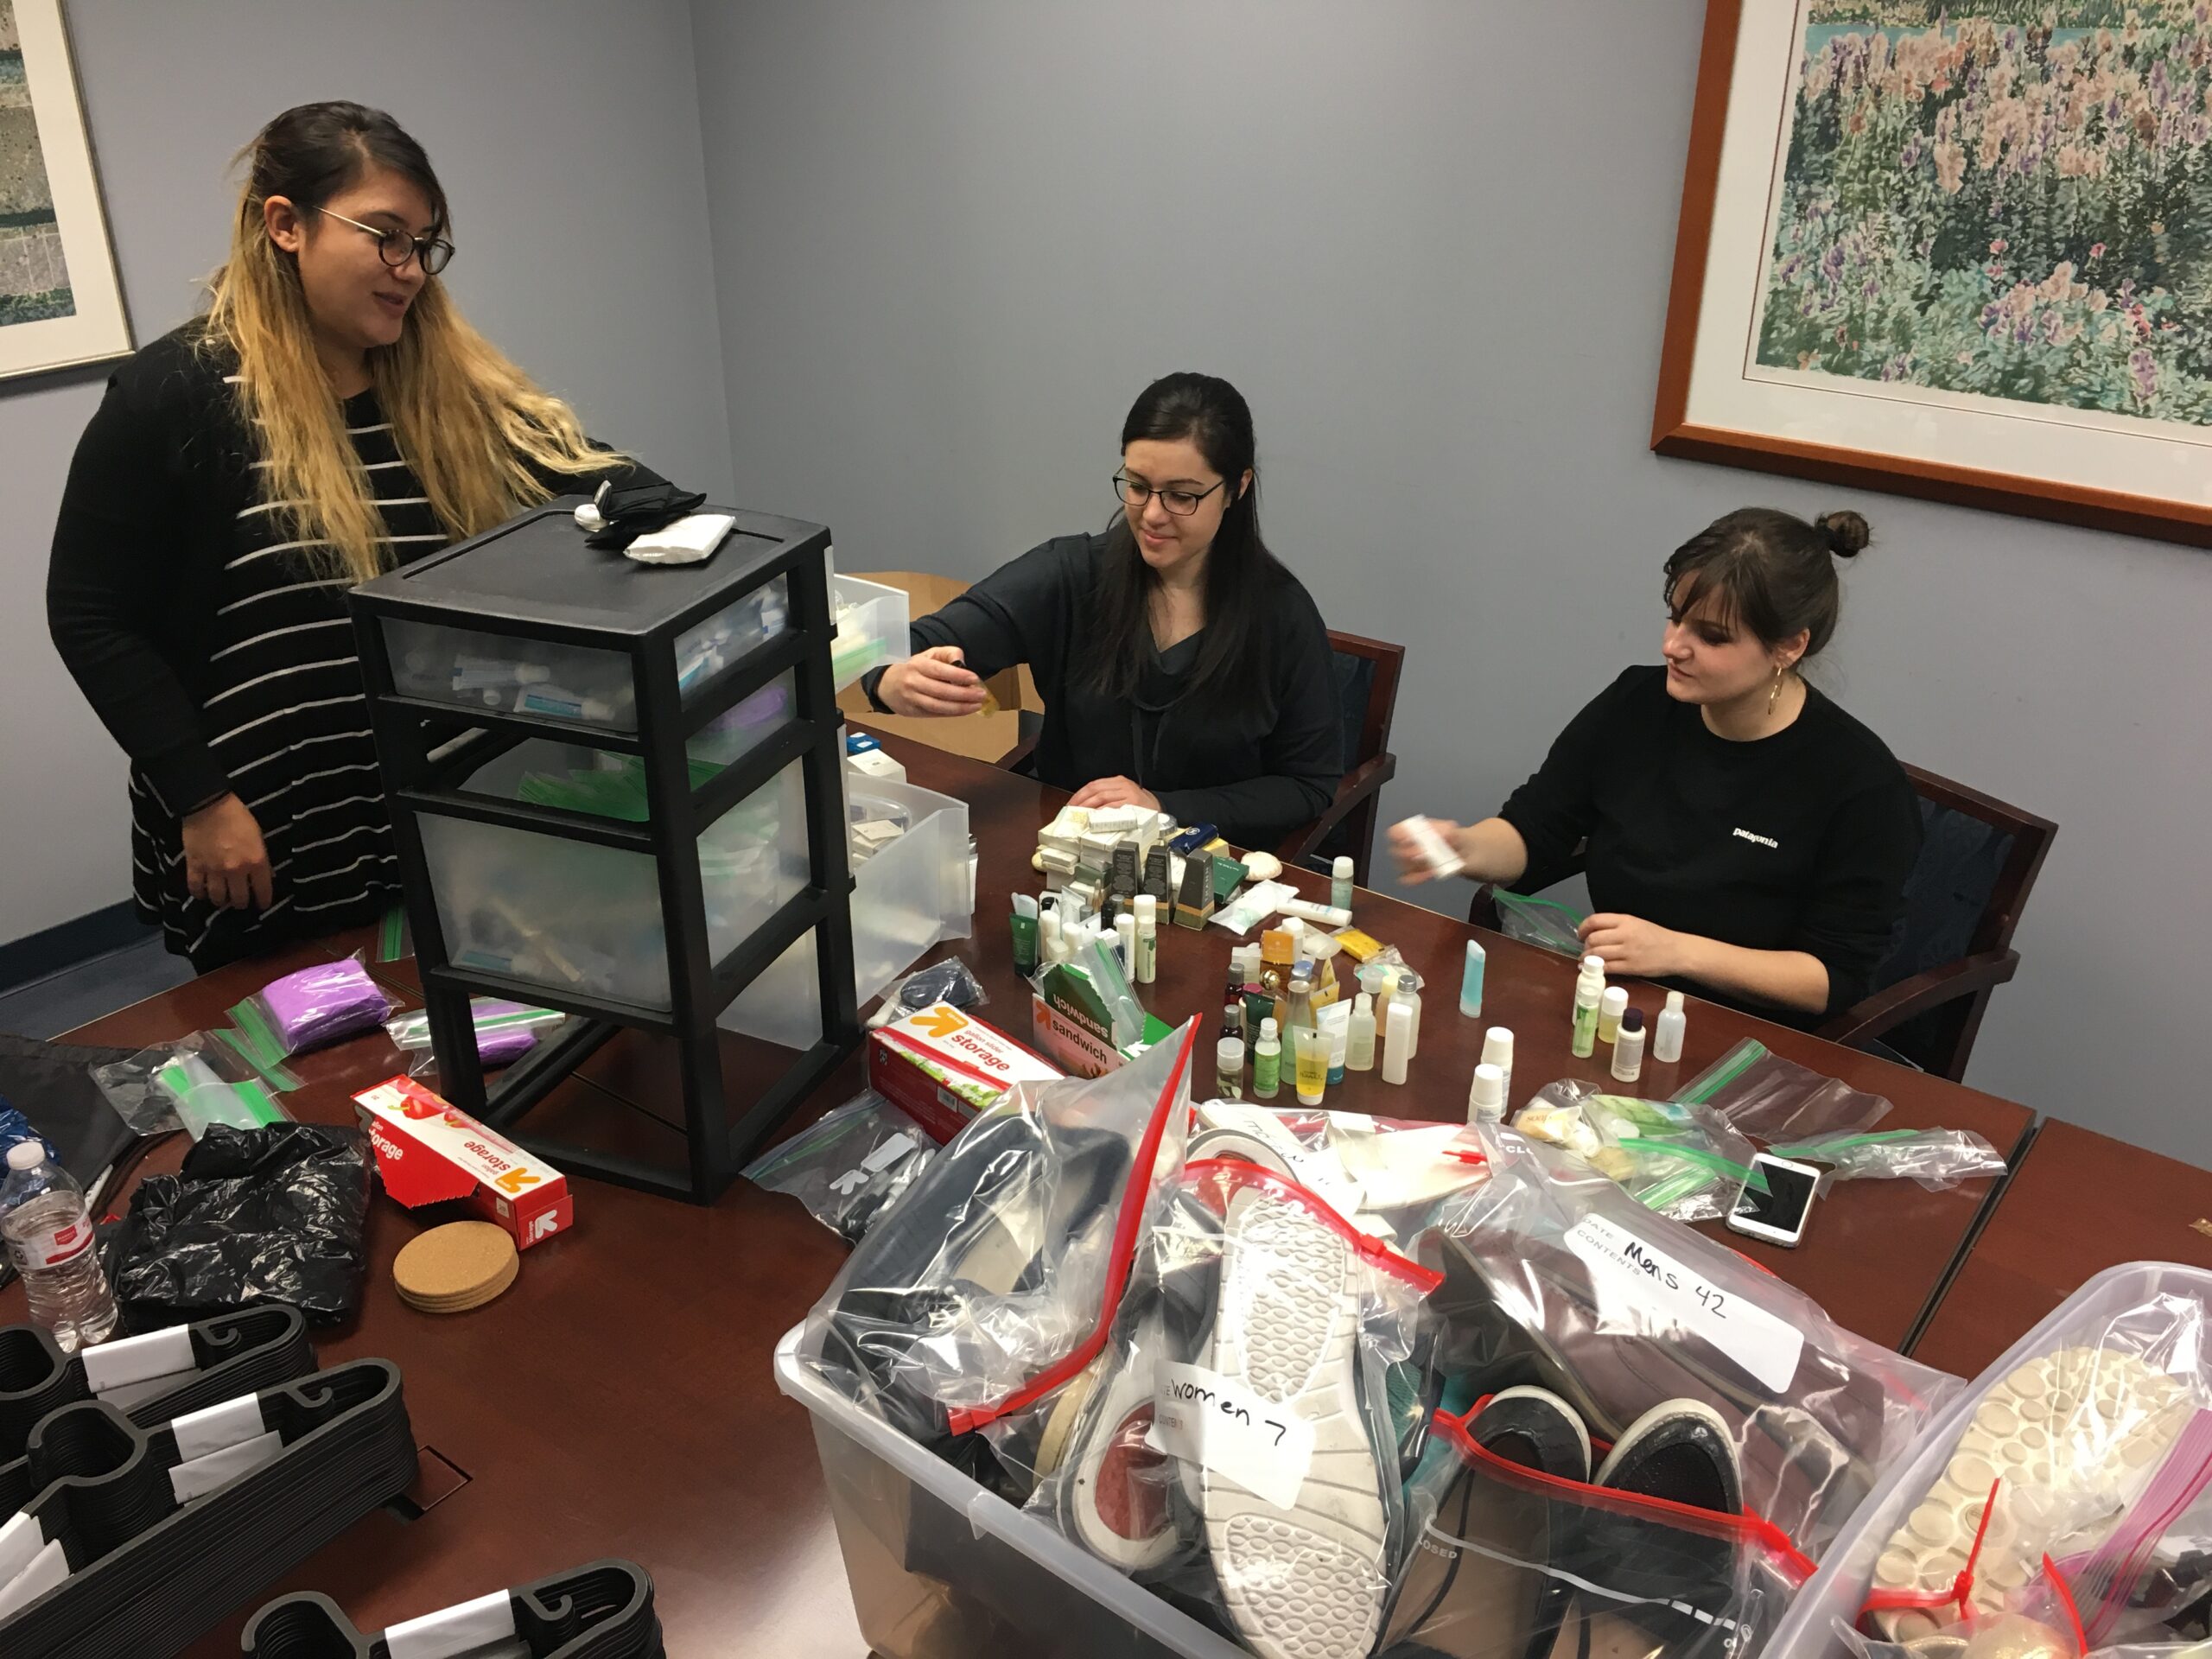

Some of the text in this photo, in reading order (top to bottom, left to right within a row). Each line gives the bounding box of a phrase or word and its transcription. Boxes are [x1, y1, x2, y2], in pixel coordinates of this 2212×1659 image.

[1732, 827, 1778, 849] patagonia
[1053, 994, 1109, 1038] sandwich
[951, 1034, 1010, 1071] storage
[963, 1030, 986, 1043] gallon
[1052, 1020, 1107, 1065] sandwich
[368, 1128, 404, 1160] torage
[463, 1141, 512, 1172] storage
[1583, 1217, 1614, 1240] DATE
[1576, 1230, 1641, 1276] CONTENTS
[1695, 1286, 1727, 1319] 42
[1265, 1419, 1287, 1446] 7
